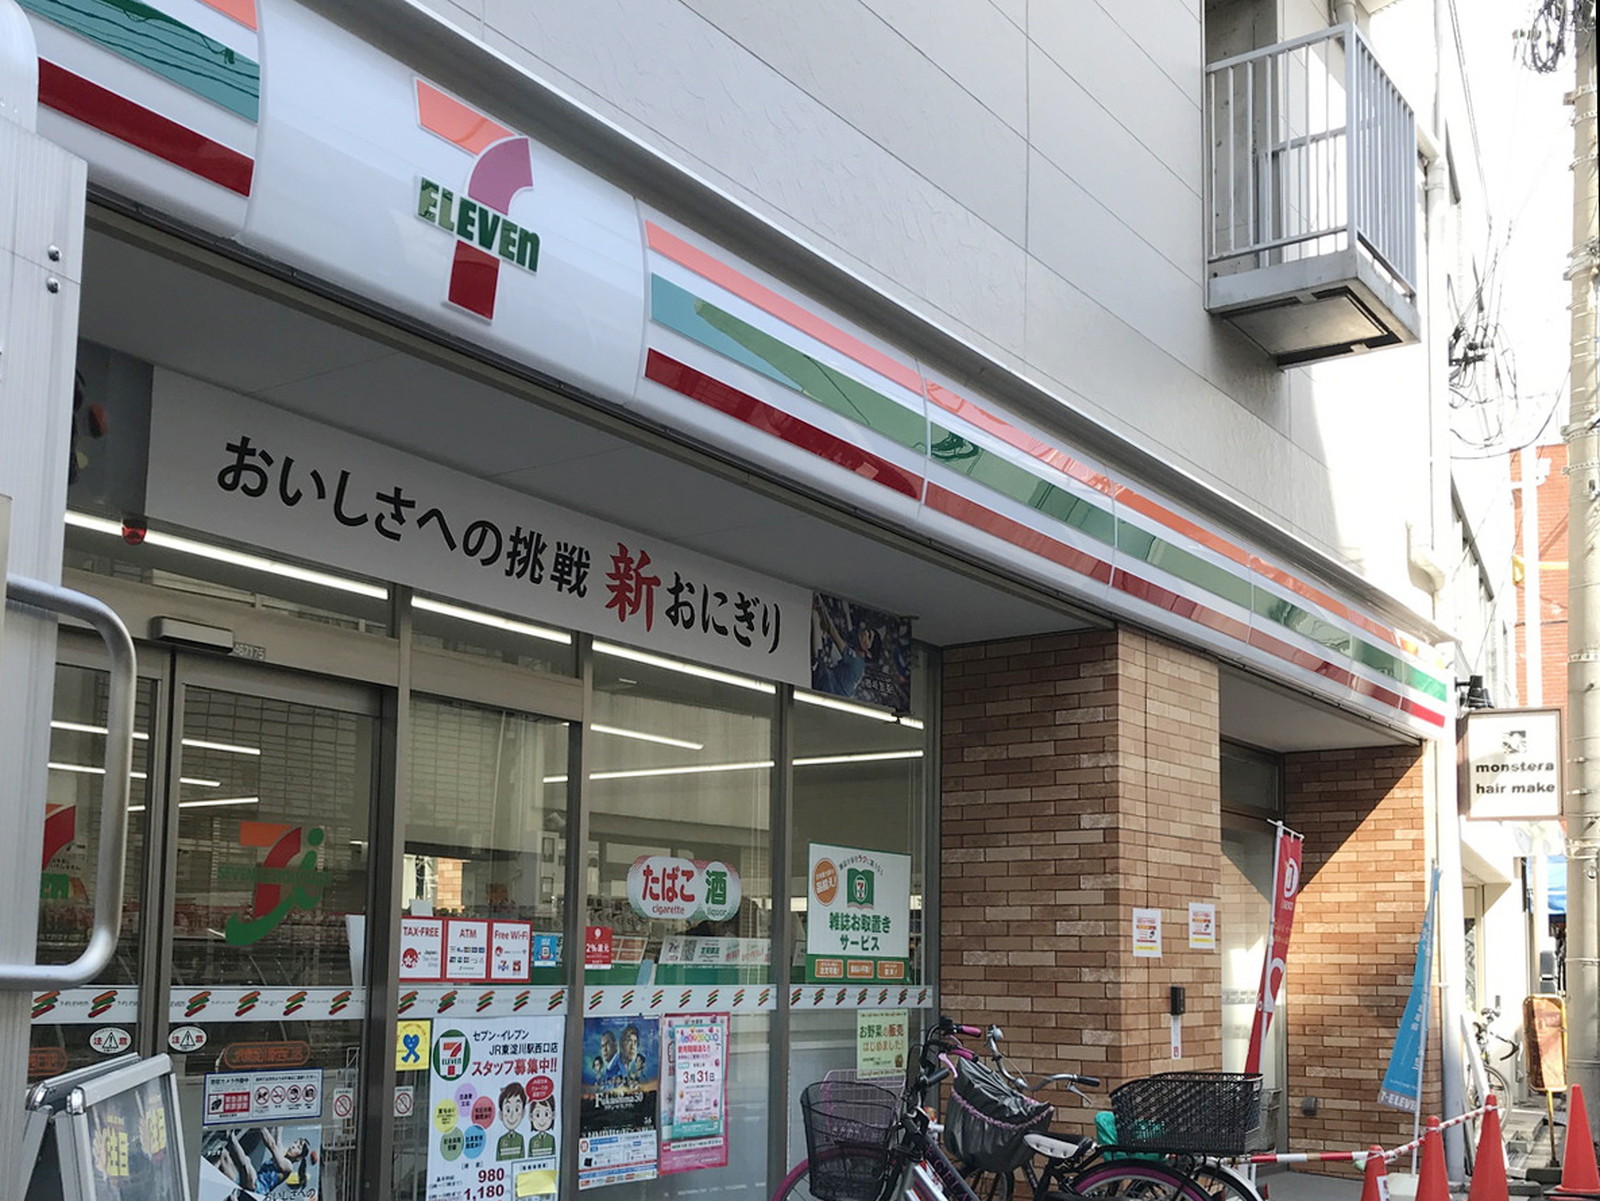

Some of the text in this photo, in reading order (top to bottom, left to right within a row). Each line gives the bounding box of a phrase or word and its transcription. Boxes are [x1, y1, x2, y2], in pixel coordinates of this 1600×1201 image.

[217, 435, 591, 598] おいしさへの挑戦
[1475, 762, 1554, 772] monstera
[1476, 782, 1555, 794] hair make
[641, 864, 695, 903] たばこ
[705, 869, 728, 905] 酒
[652, 904, 685, 915] cigarette
[707, 906, 727, 917] liquor
[829, 911, 891, 934] 雑誌お取置き
[403, 926, 440, 938] TAX-FREE
[459, 929, 477, 938] ATM
[494, 930, 529, 940] Free Wi-Fi
[840, 934, 880, 951] サービス
[473, 1029, 530, 1042] セブン・イレブン
[860, 1024, 904, 1038] お野菜の販売
[489, 1042, 559, 1056] JR東淀川駅西口店
[683, 1070, 715, 1084] 3月31日
[1380, 1090, 1418, 1112] 7-ELEVE
[478, 1167, 505, 1183] 980
[464, 1184, 505, 1201] 1,180
